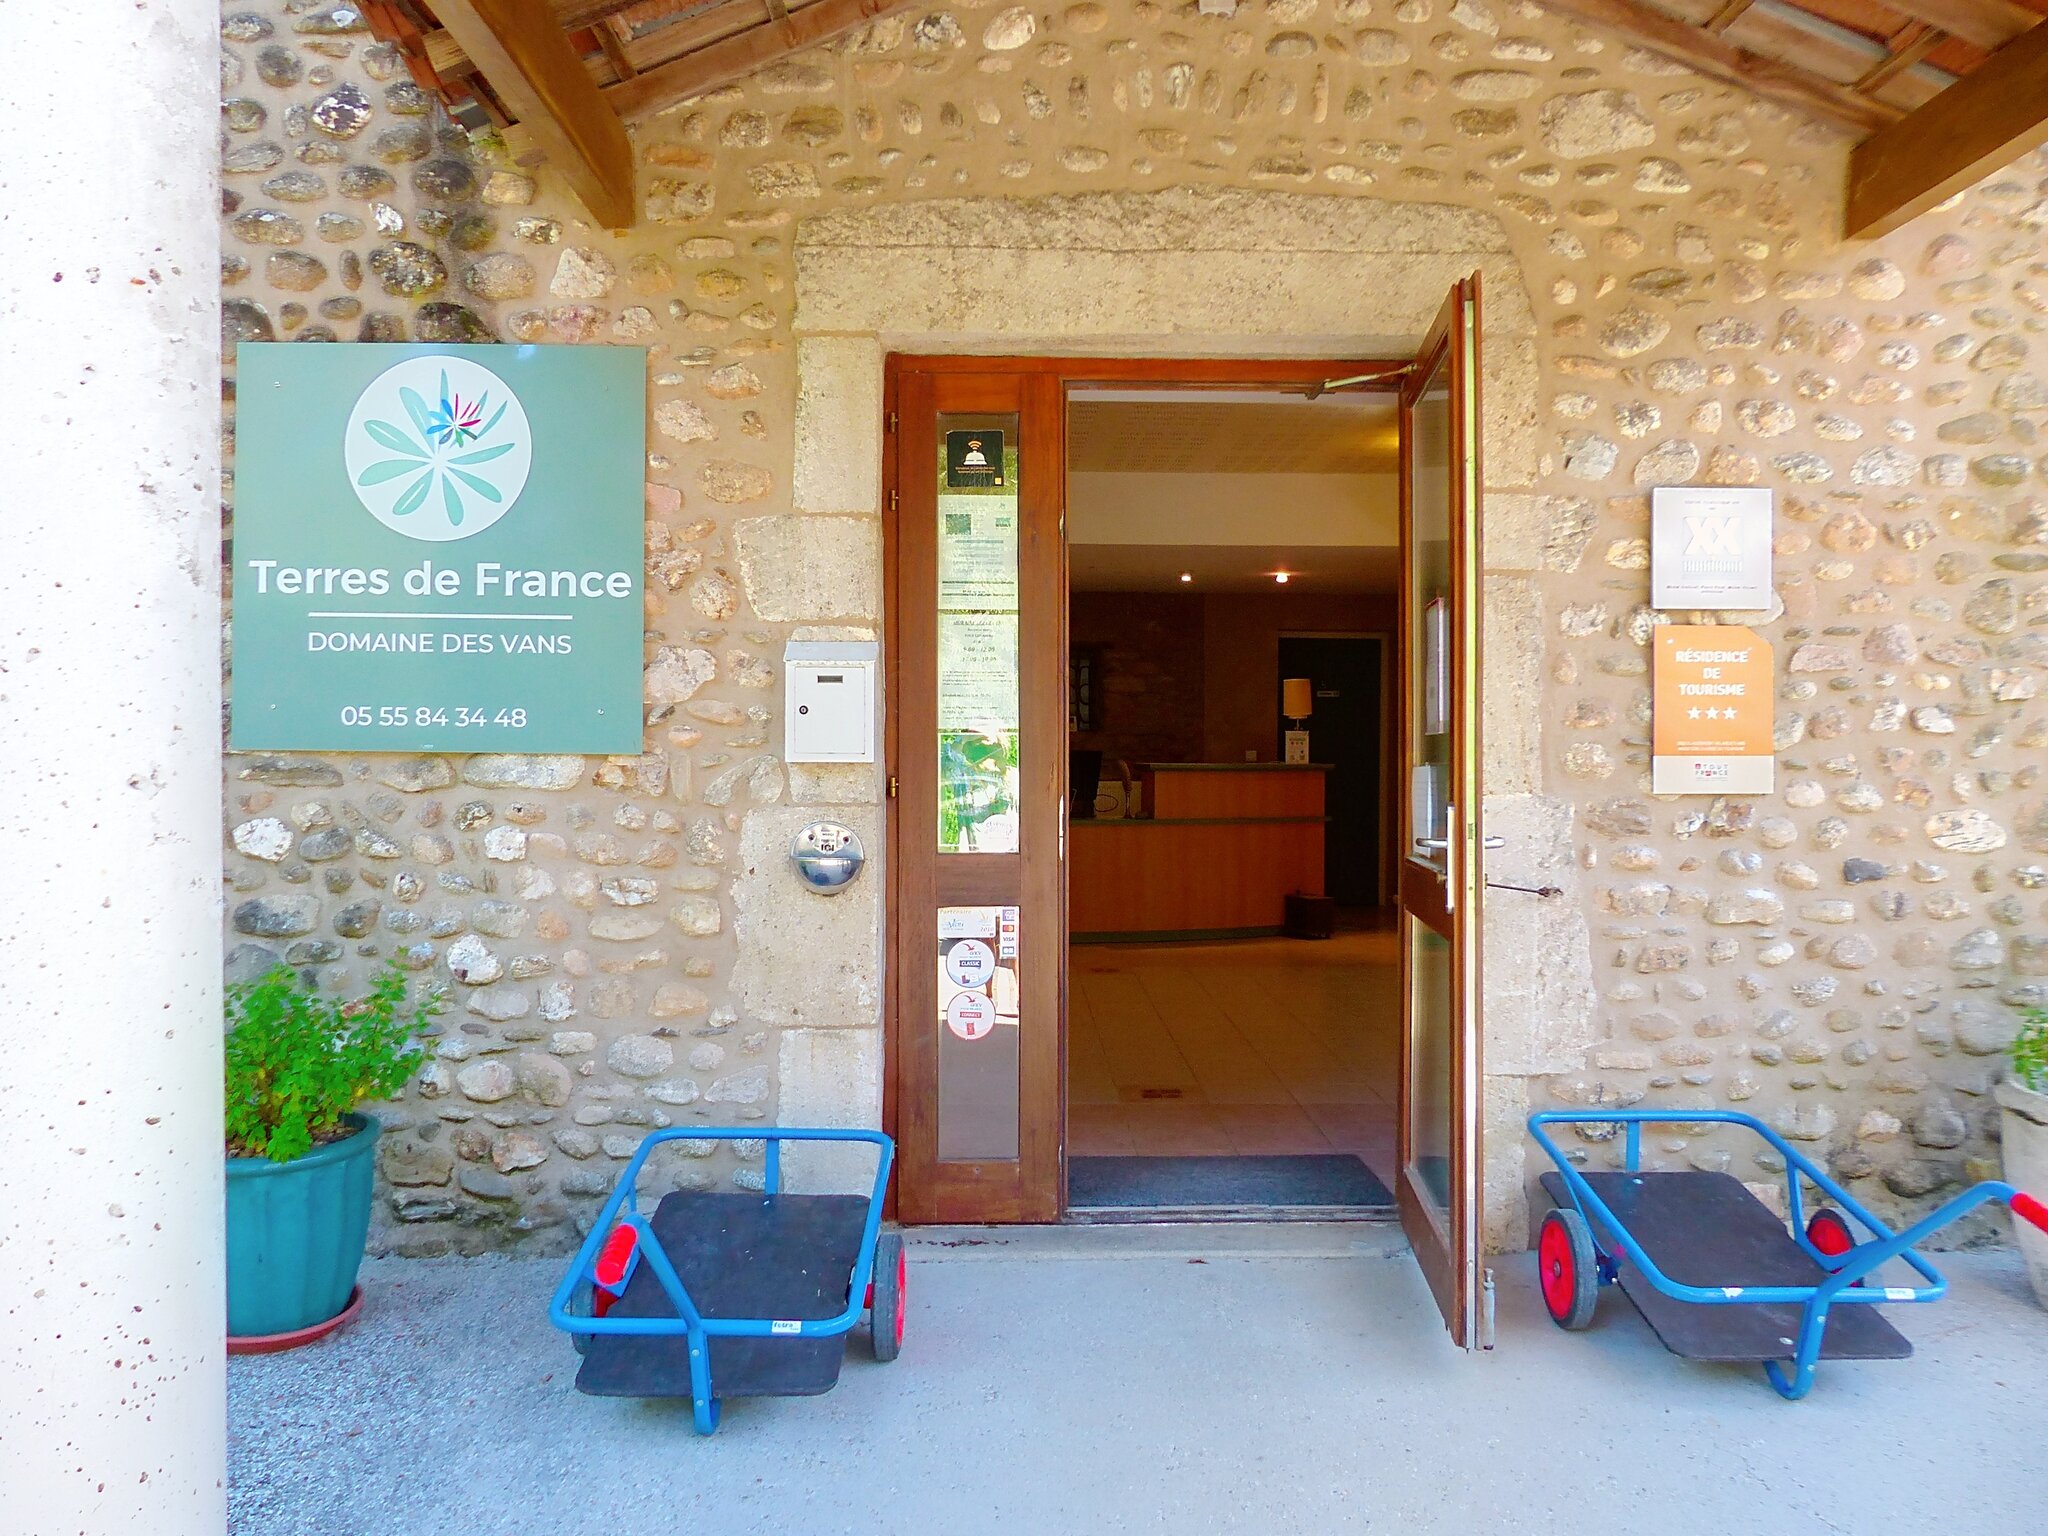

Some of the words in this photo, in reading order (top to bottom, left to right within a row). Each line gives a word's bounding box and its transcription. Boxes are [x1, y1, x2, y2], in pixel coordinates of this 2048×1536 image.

[249, 559, 389, 595] Terres
[403, 561, 460, 596] de
[476, 562, 632, 598] France
[308, 632, 434, 653] DOMAINE
[442, 633, 494, 654] DES
[501, 634, 572, 655] VANS
[1675, 648, 1749, 663] RÉSIDENCE
[1703, 667, 1721, 679] DE
[1678, 683, 1745, 696] TOURISME
[341, 706, 372, 727] 05
[379, 706, 408, 727] 55
[415, 707, 449, 728] 84
[455, 707, 487, 728] 34
[494, 707, 527, 728] 48
